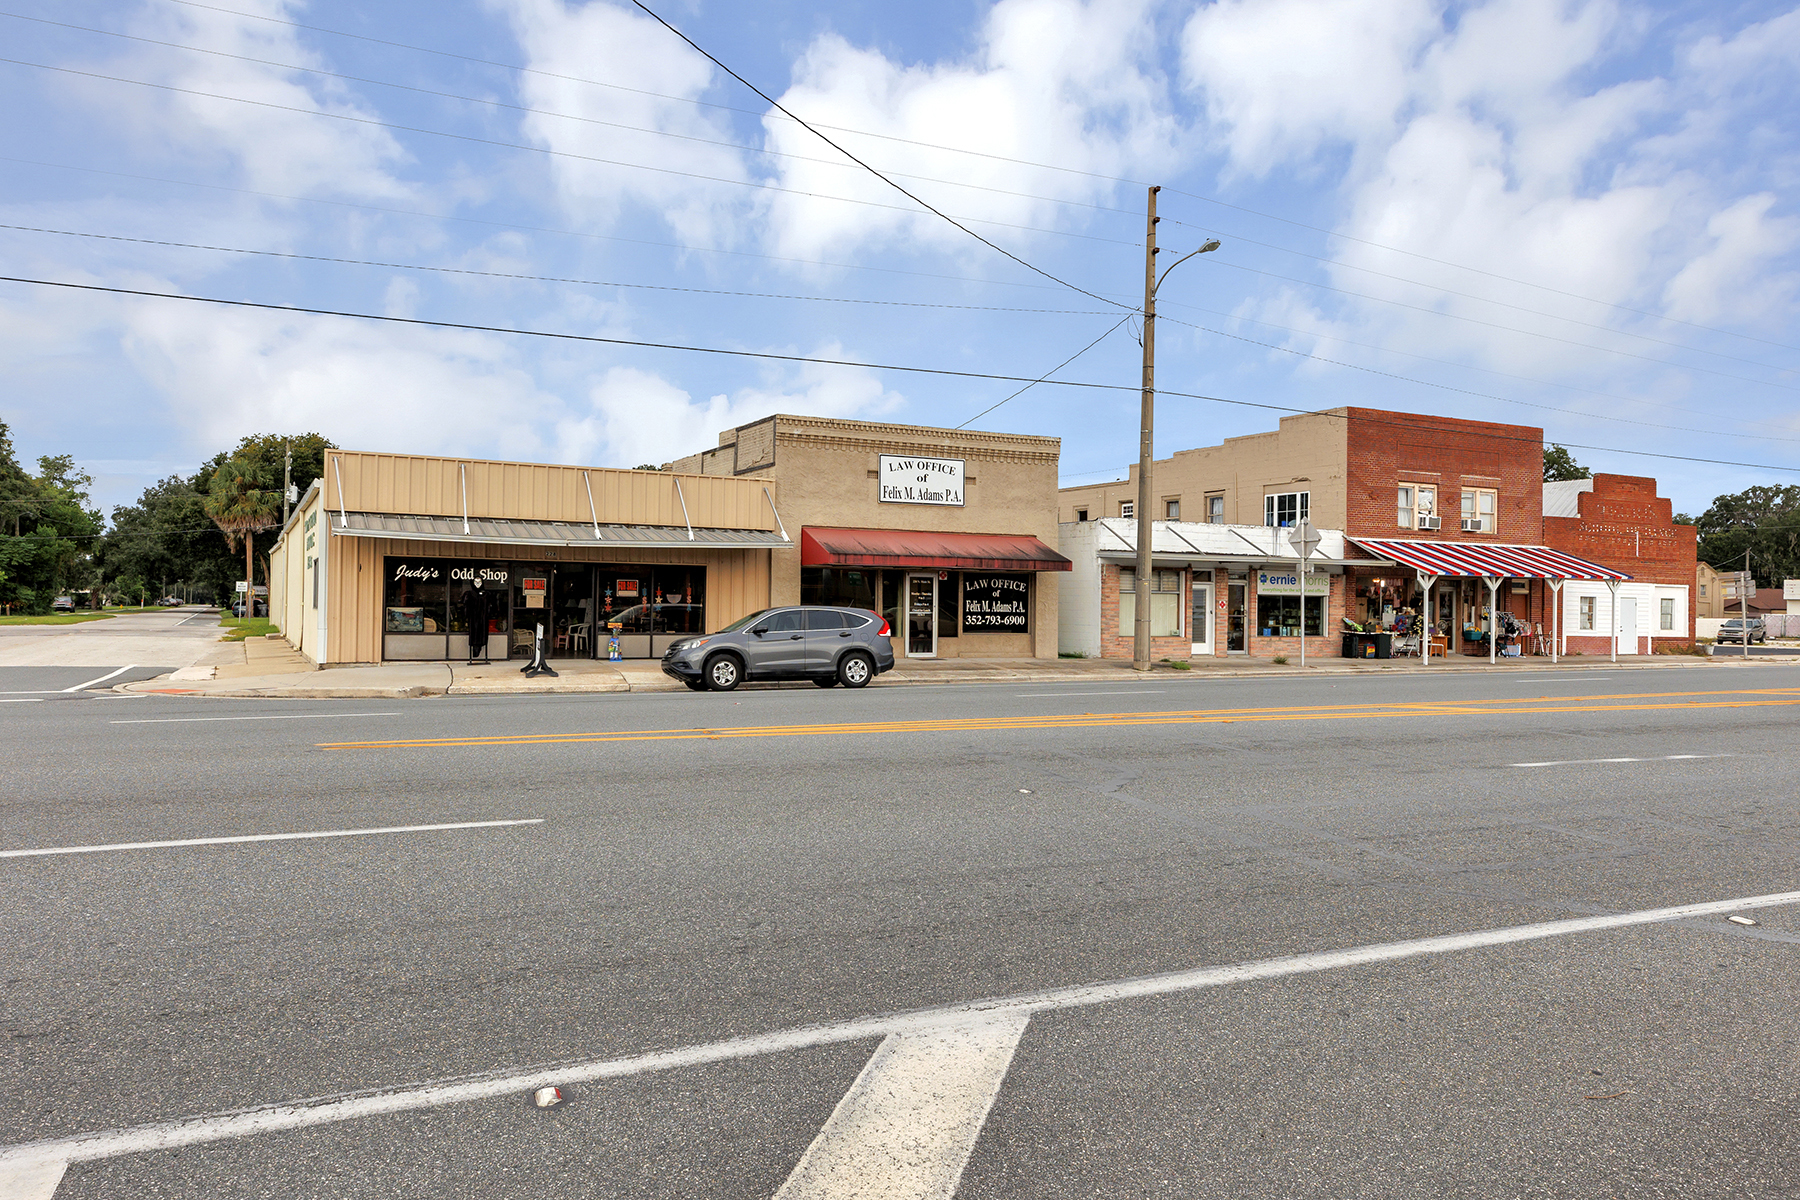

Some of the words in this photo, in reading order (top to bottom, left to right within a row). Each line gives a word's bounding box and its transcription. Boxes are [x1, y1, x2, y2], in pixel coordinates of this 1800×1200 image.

[889, 461, 914, 472] LAW
[917, 461, 956, 476] OFFICE
[916, 474, 929, 482] of
[883, 485, 902, 499] Felix
[904, 486, 915, 500] M.
[917, 487, 943, 502] Adams
[945, 489, 961, 502] P.A.
[394, 564, 439, 581] Judy's
[451, 568, 474, 580] Odd
[479, 568, 508, 583] Shop
[1269, 574, 1297, 585] ernie
[524, 579, 533, 589] FOR
[534, 579, 545, 589] SALE
[618, 581, 626, 590] FOR
[627, 581, 637, 591] SALE
[966, 579, 989, 591] LAW
[991, 579, 1026, 592] OFFICE
[966, 600, 981, 612] Felix
[981, 600, 991, 612] M.
[991, 600, 1012, 613] Adams
[1012, 601, 1025, 613] P.A.
[965, 615, 1025, 625] 352-793-6900
